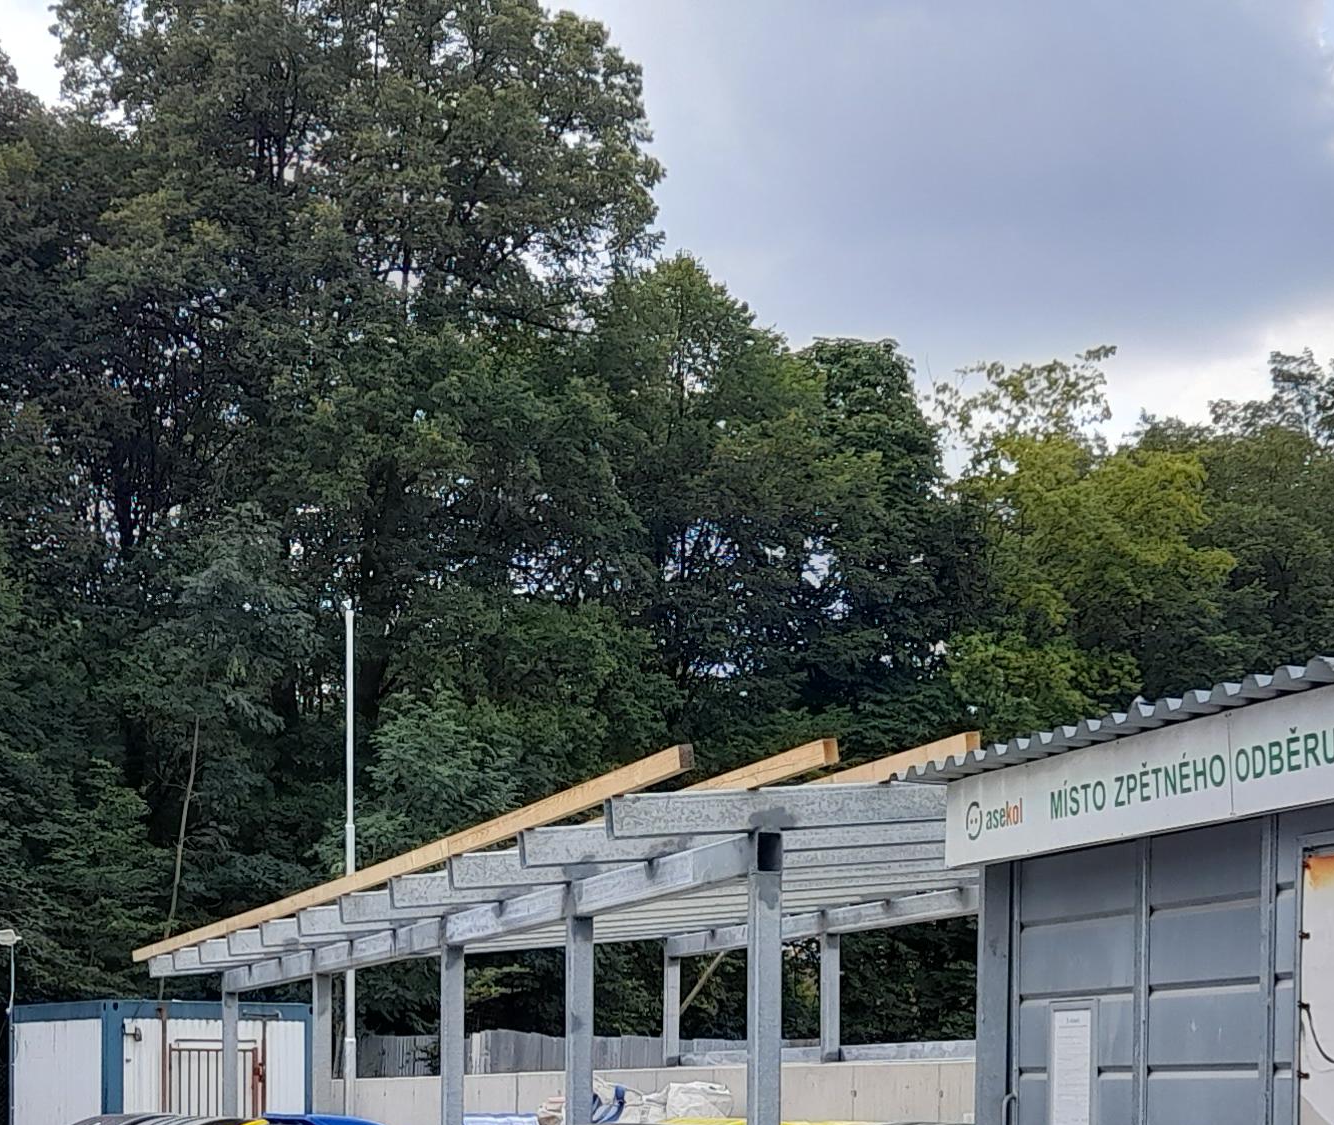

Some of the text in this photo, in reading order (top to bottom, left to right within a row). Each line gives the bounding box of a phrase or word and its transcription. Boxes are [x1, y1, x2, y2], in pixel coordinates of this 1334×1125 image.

[1050, 780, 1106, 820] MÍSTO
[1114, 752, 1226, 808] ZPĚTNÉHO
[985, 797, 1023, 830] asekol
